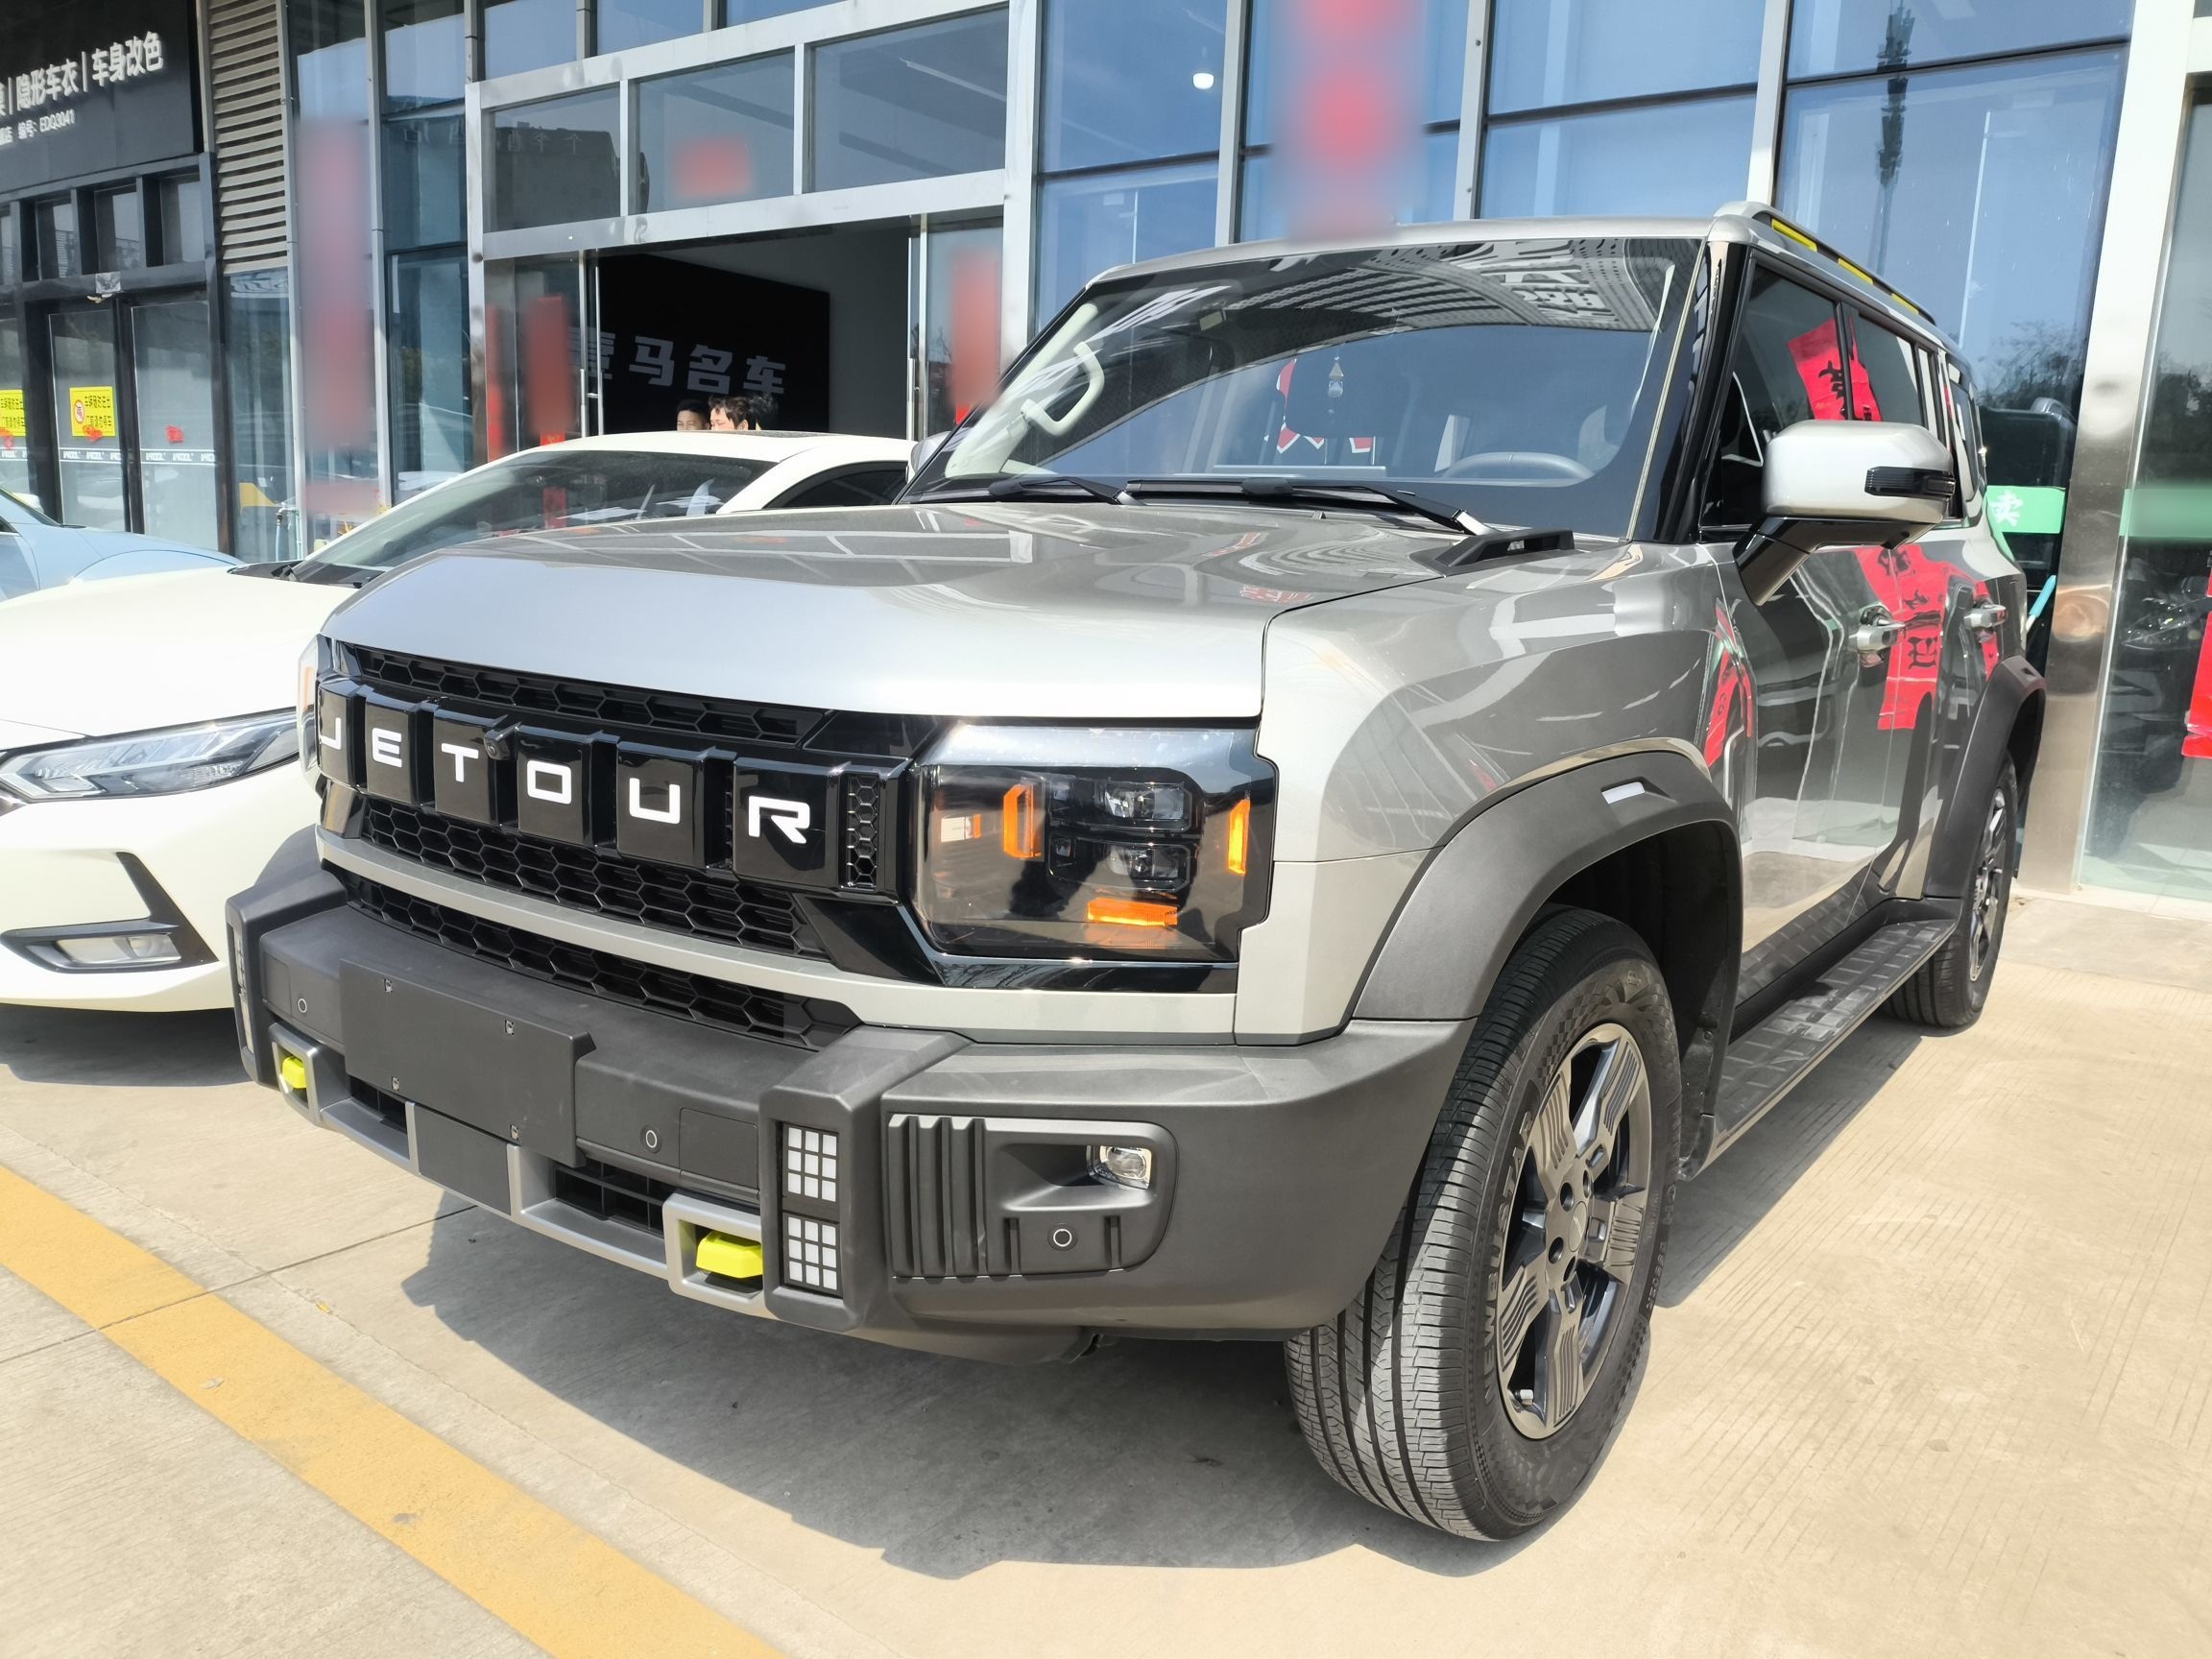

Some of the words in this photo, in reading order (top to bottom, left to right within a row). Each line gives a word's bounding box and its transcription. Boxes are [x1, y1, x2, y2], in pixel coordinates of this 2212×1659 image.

[15, 58, 80, 111] 隐形车衣
[91, 31, 164, 86] 车身改色
[319, 716, 811, 846] JETOUR
